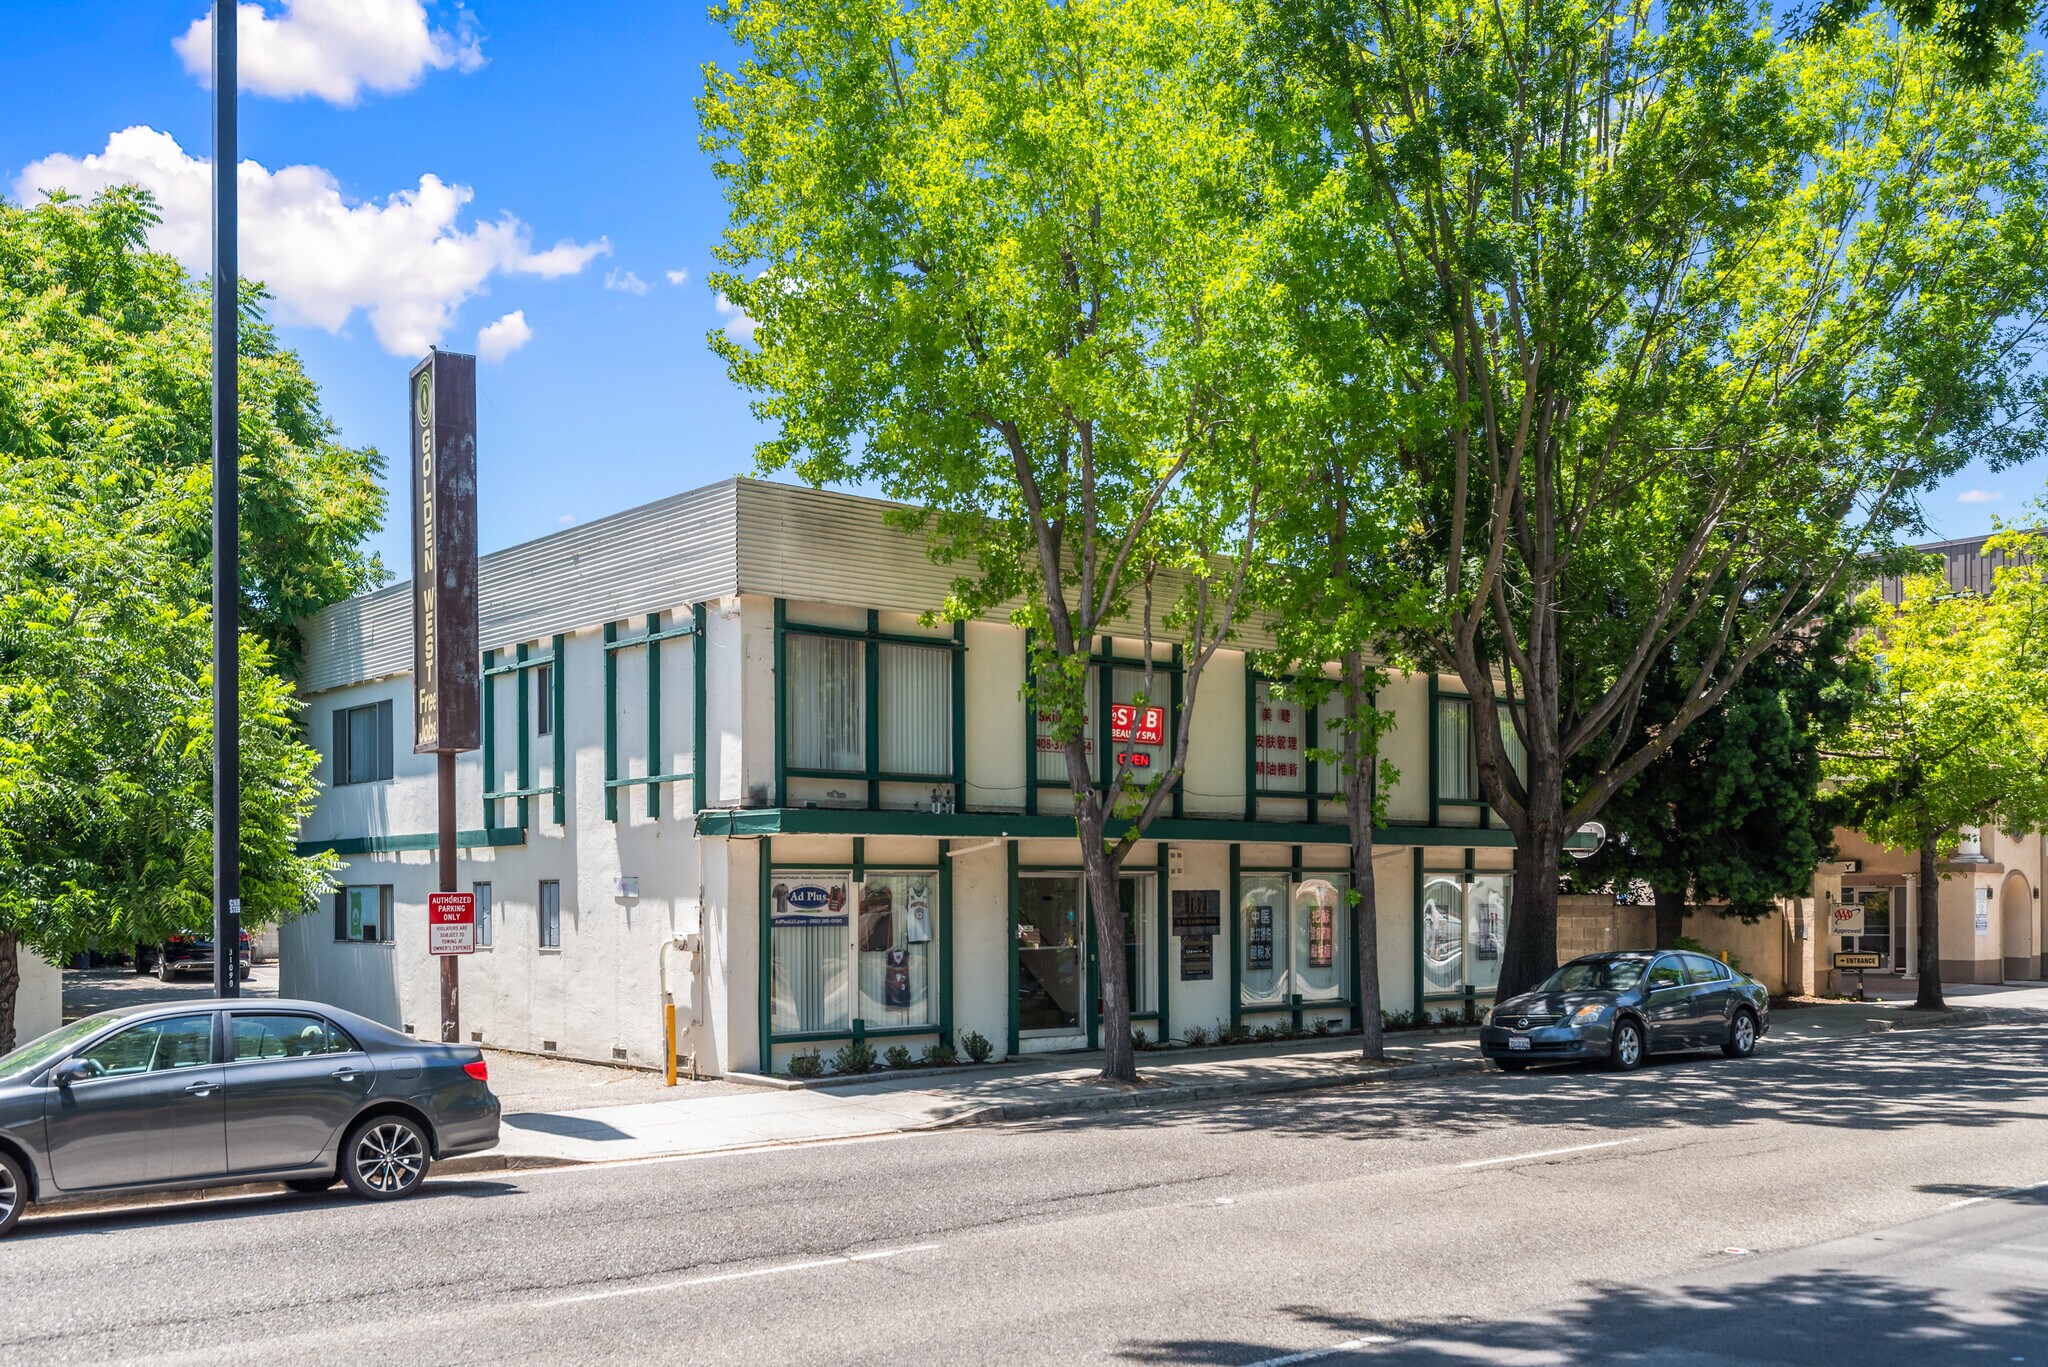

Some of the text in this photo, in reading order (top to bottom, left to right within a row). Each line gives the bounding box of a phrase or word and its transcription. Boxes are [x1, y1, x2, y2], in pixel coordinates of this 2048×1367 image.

[421, 428, 434, 573] GOLDEN
[423, 586, 435, 682] WEST
[419, 688, 437, 714] Free
[418, 716, 437, 744] Jobs
[1112, 728, 1157, 740] BEAUY SPA
[1255, 734, 1297, 750] 皮肤管理
[1255, 761, 1298, 778] 精油推背
[432, 896, 471, 904] AUTHORIZED
[790, 891, 827, 901] Ad Plus
[1251, 909, 1270, 924] 中医
[1835, 909, 1853, 920] AAA
